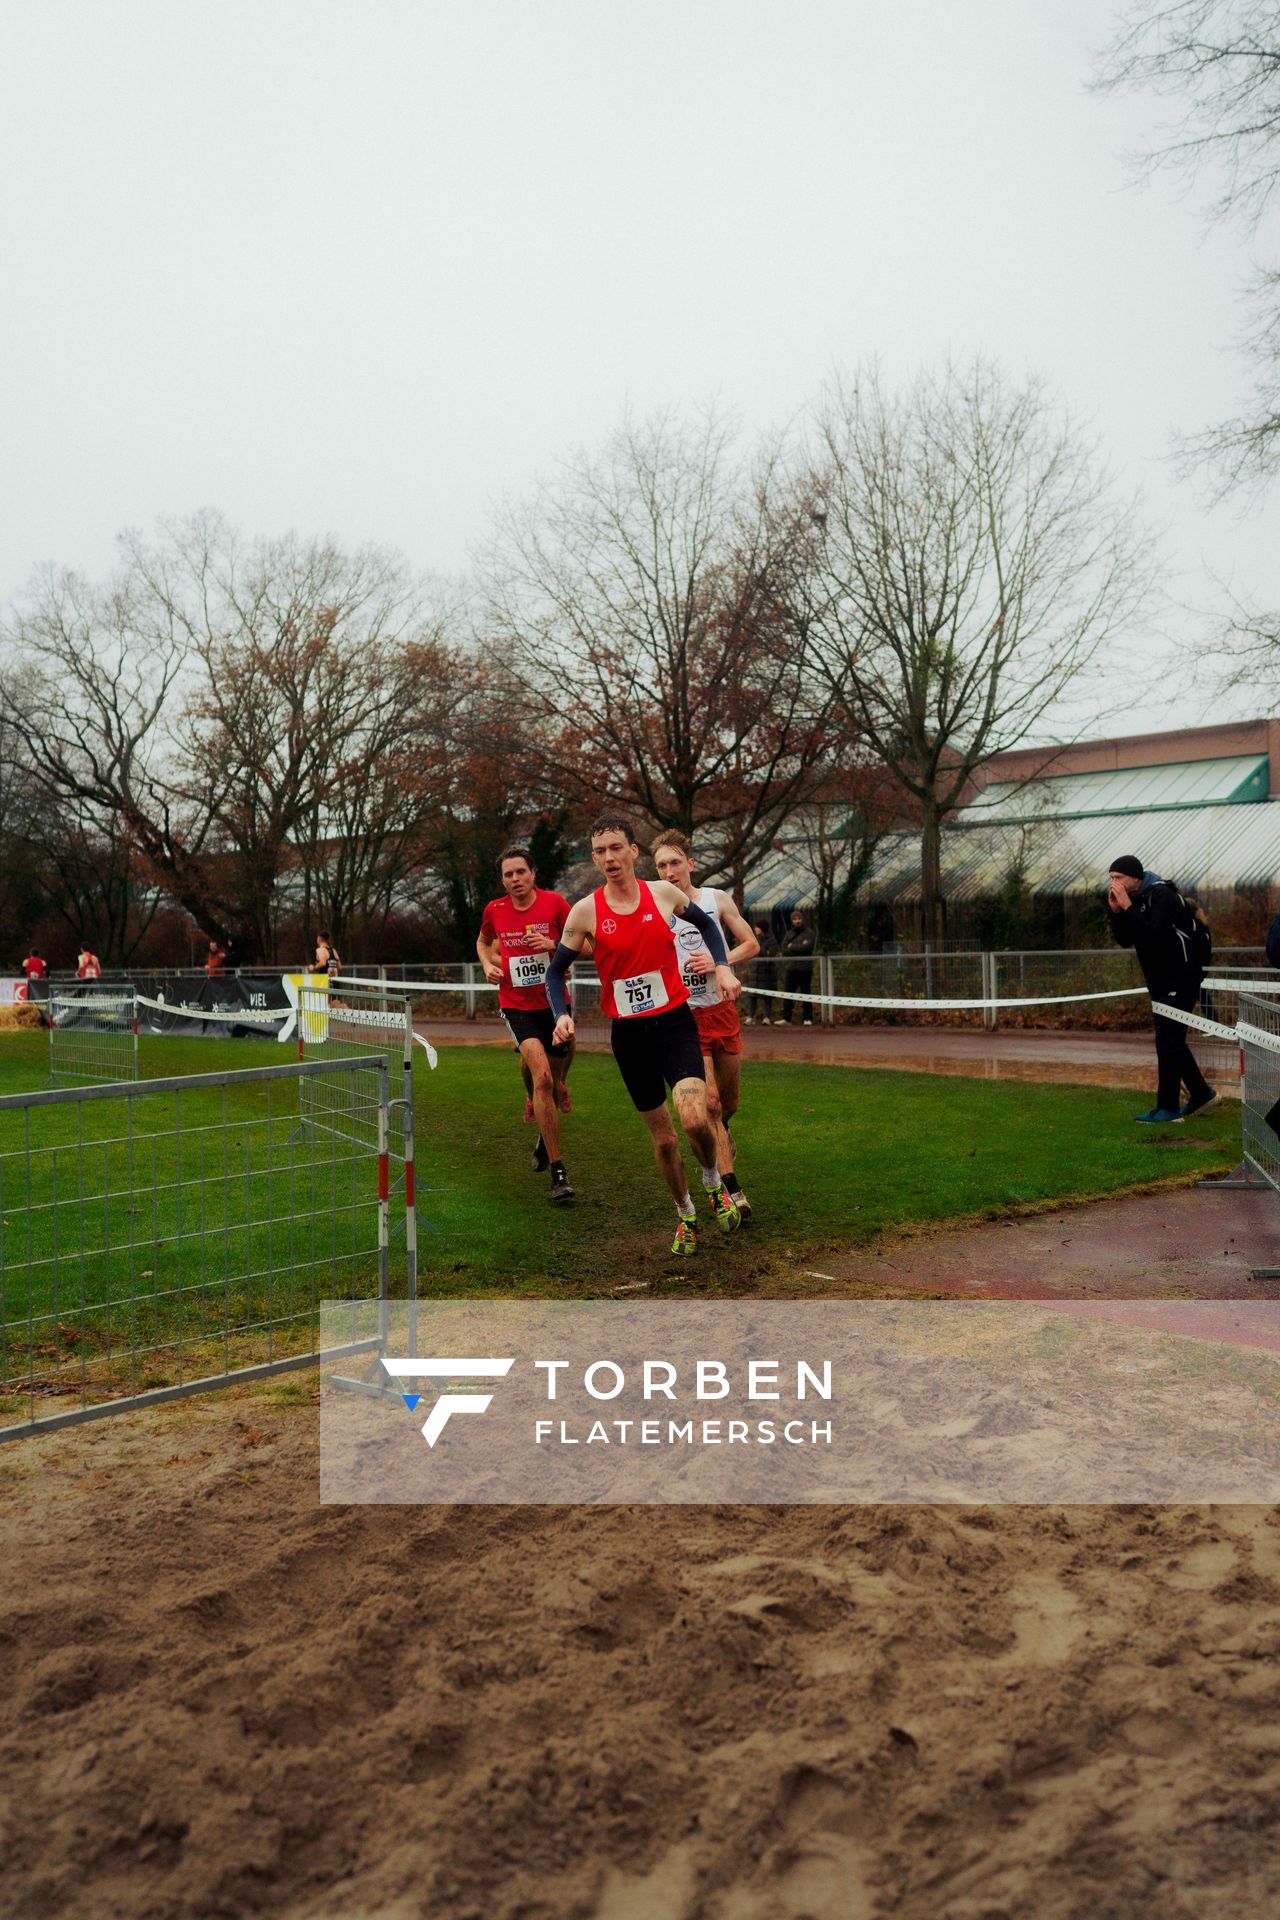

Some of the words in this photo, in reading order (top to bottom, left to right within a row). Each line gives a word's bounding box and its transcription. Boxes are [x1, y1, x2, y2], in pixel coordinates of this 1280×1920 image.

[520, 956, 535, 964] GLS
[515, 963, 545, 977] 1096
[625, 977, 644, 988] GLS
[683, 974, 707, 987] 568
[250, 993, 267, 1006] VIEL
[625, 985, 652, 1003] 757
